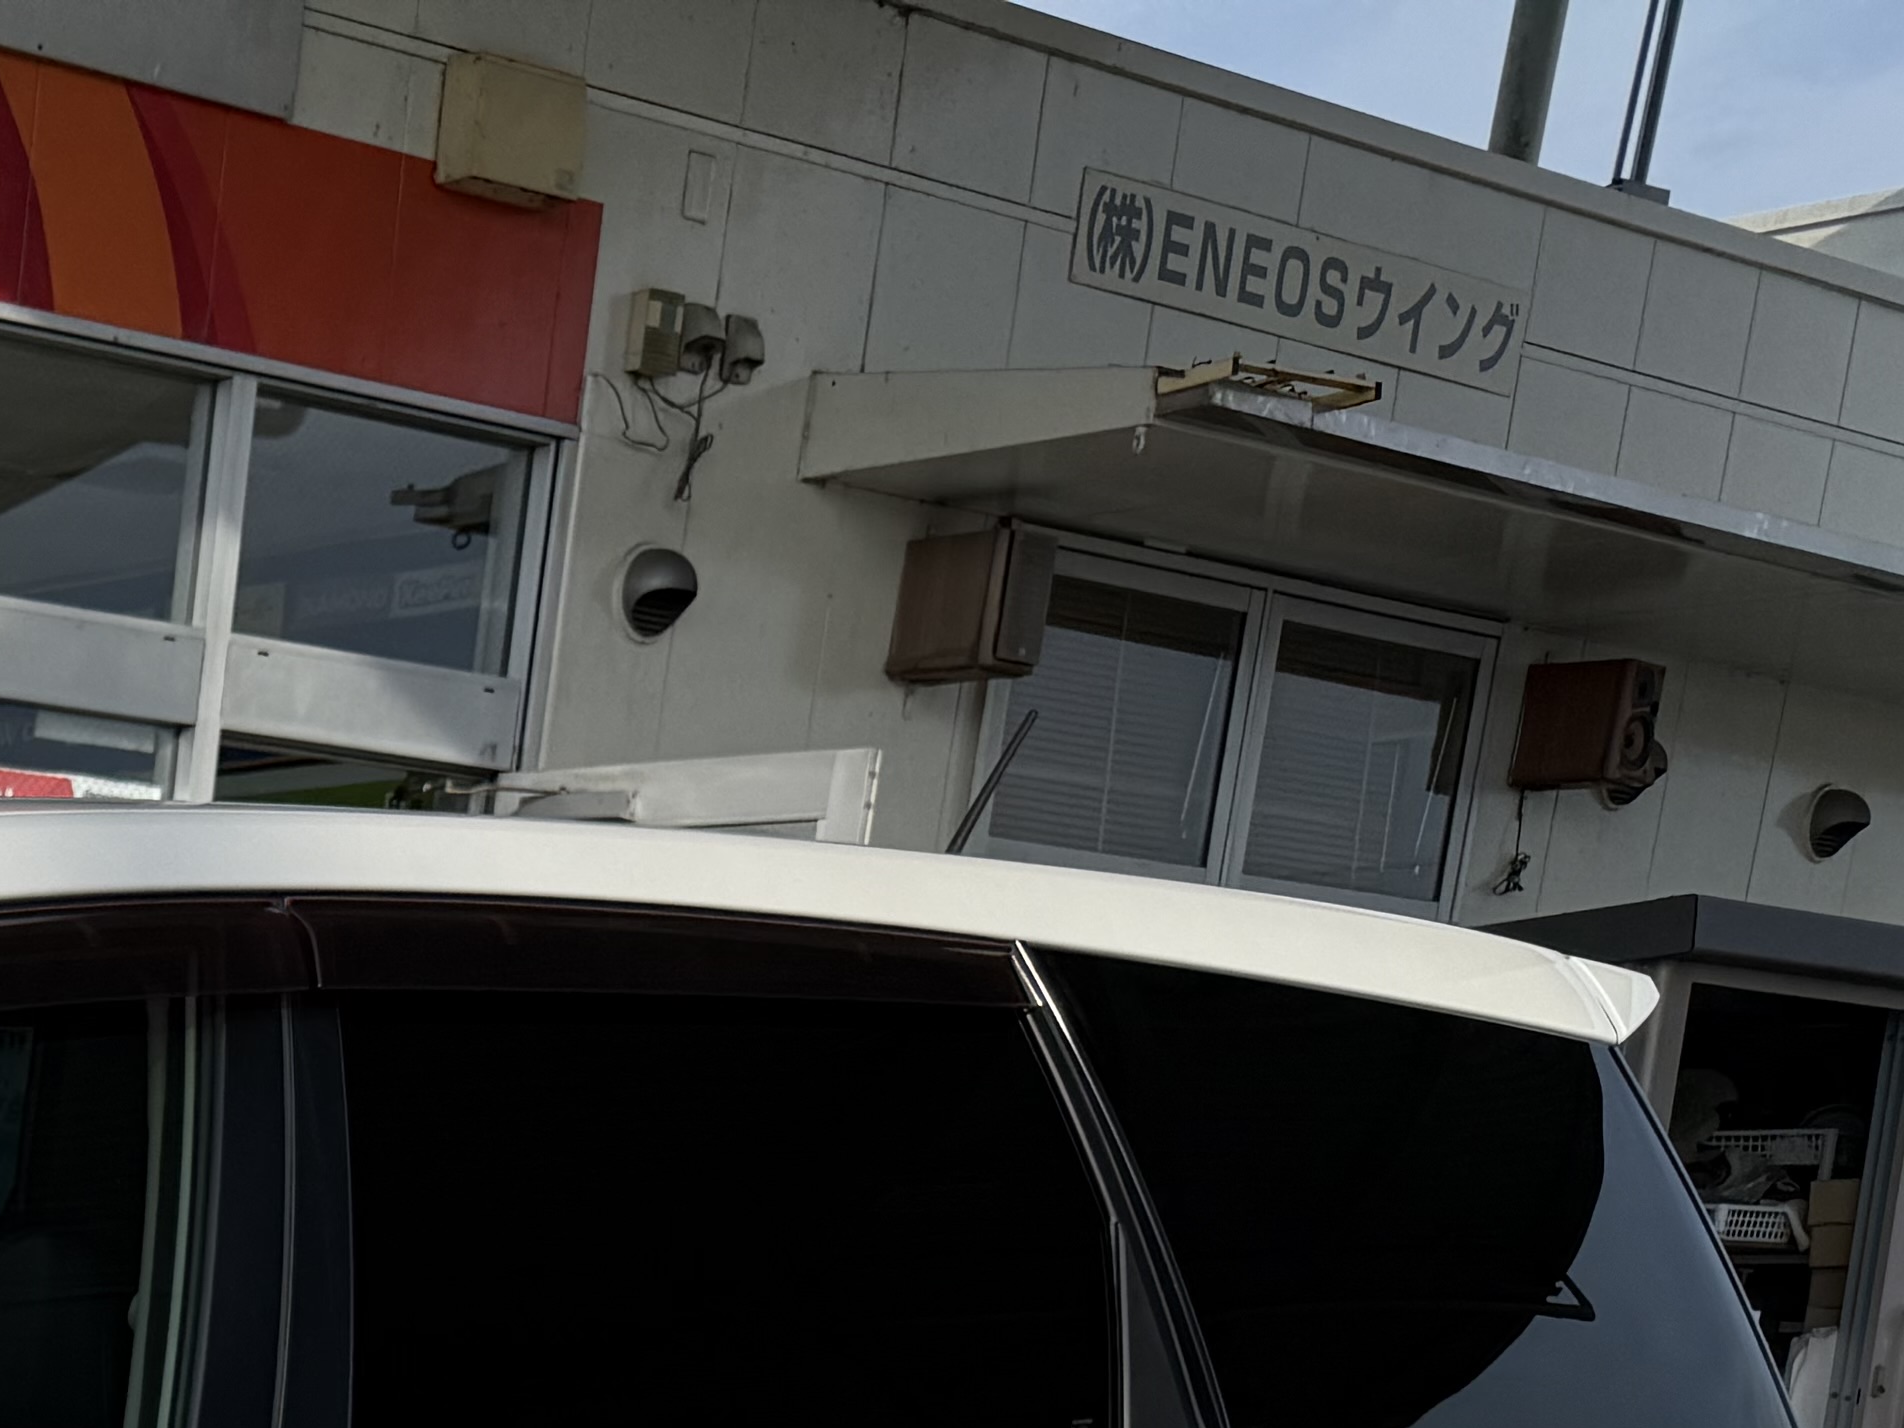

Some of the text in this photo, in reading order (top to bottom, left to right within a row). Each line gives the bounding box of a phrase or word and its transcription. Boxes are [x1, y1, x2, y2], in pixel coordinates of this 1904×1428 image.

[1085, 183, 1521, 373] (株)ENEOSウイング
